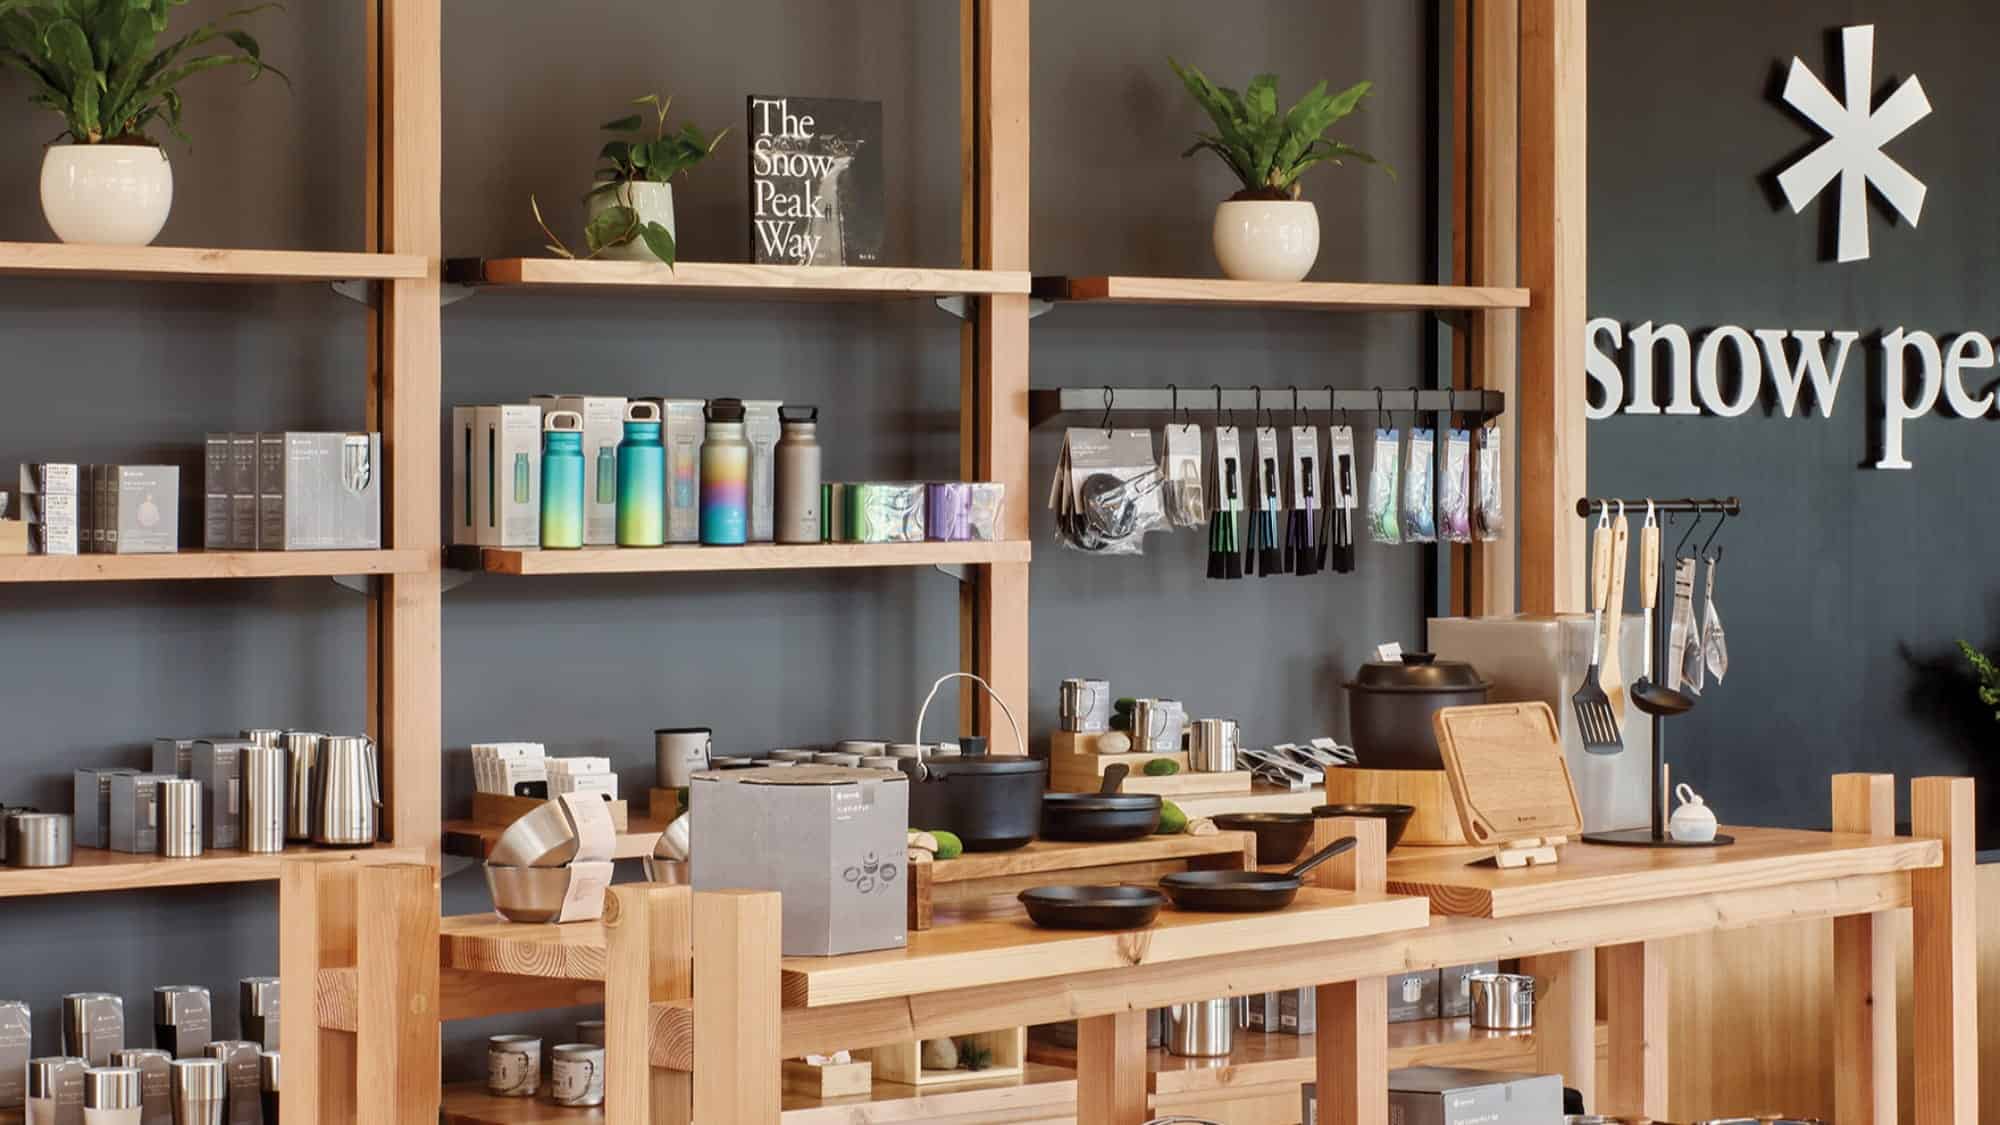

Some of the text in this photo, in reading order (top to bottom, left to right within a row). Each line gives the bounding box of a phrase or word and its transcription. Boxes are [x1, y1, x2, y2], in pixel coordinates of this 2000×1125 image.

[752, 98, 815, 138] The
[753, 138, 834, 178] Snow
[754, 179, 825, 218] Peak
[754, 219, 822, 266] Way
[1585, 317, 2000, 469] snow pe
